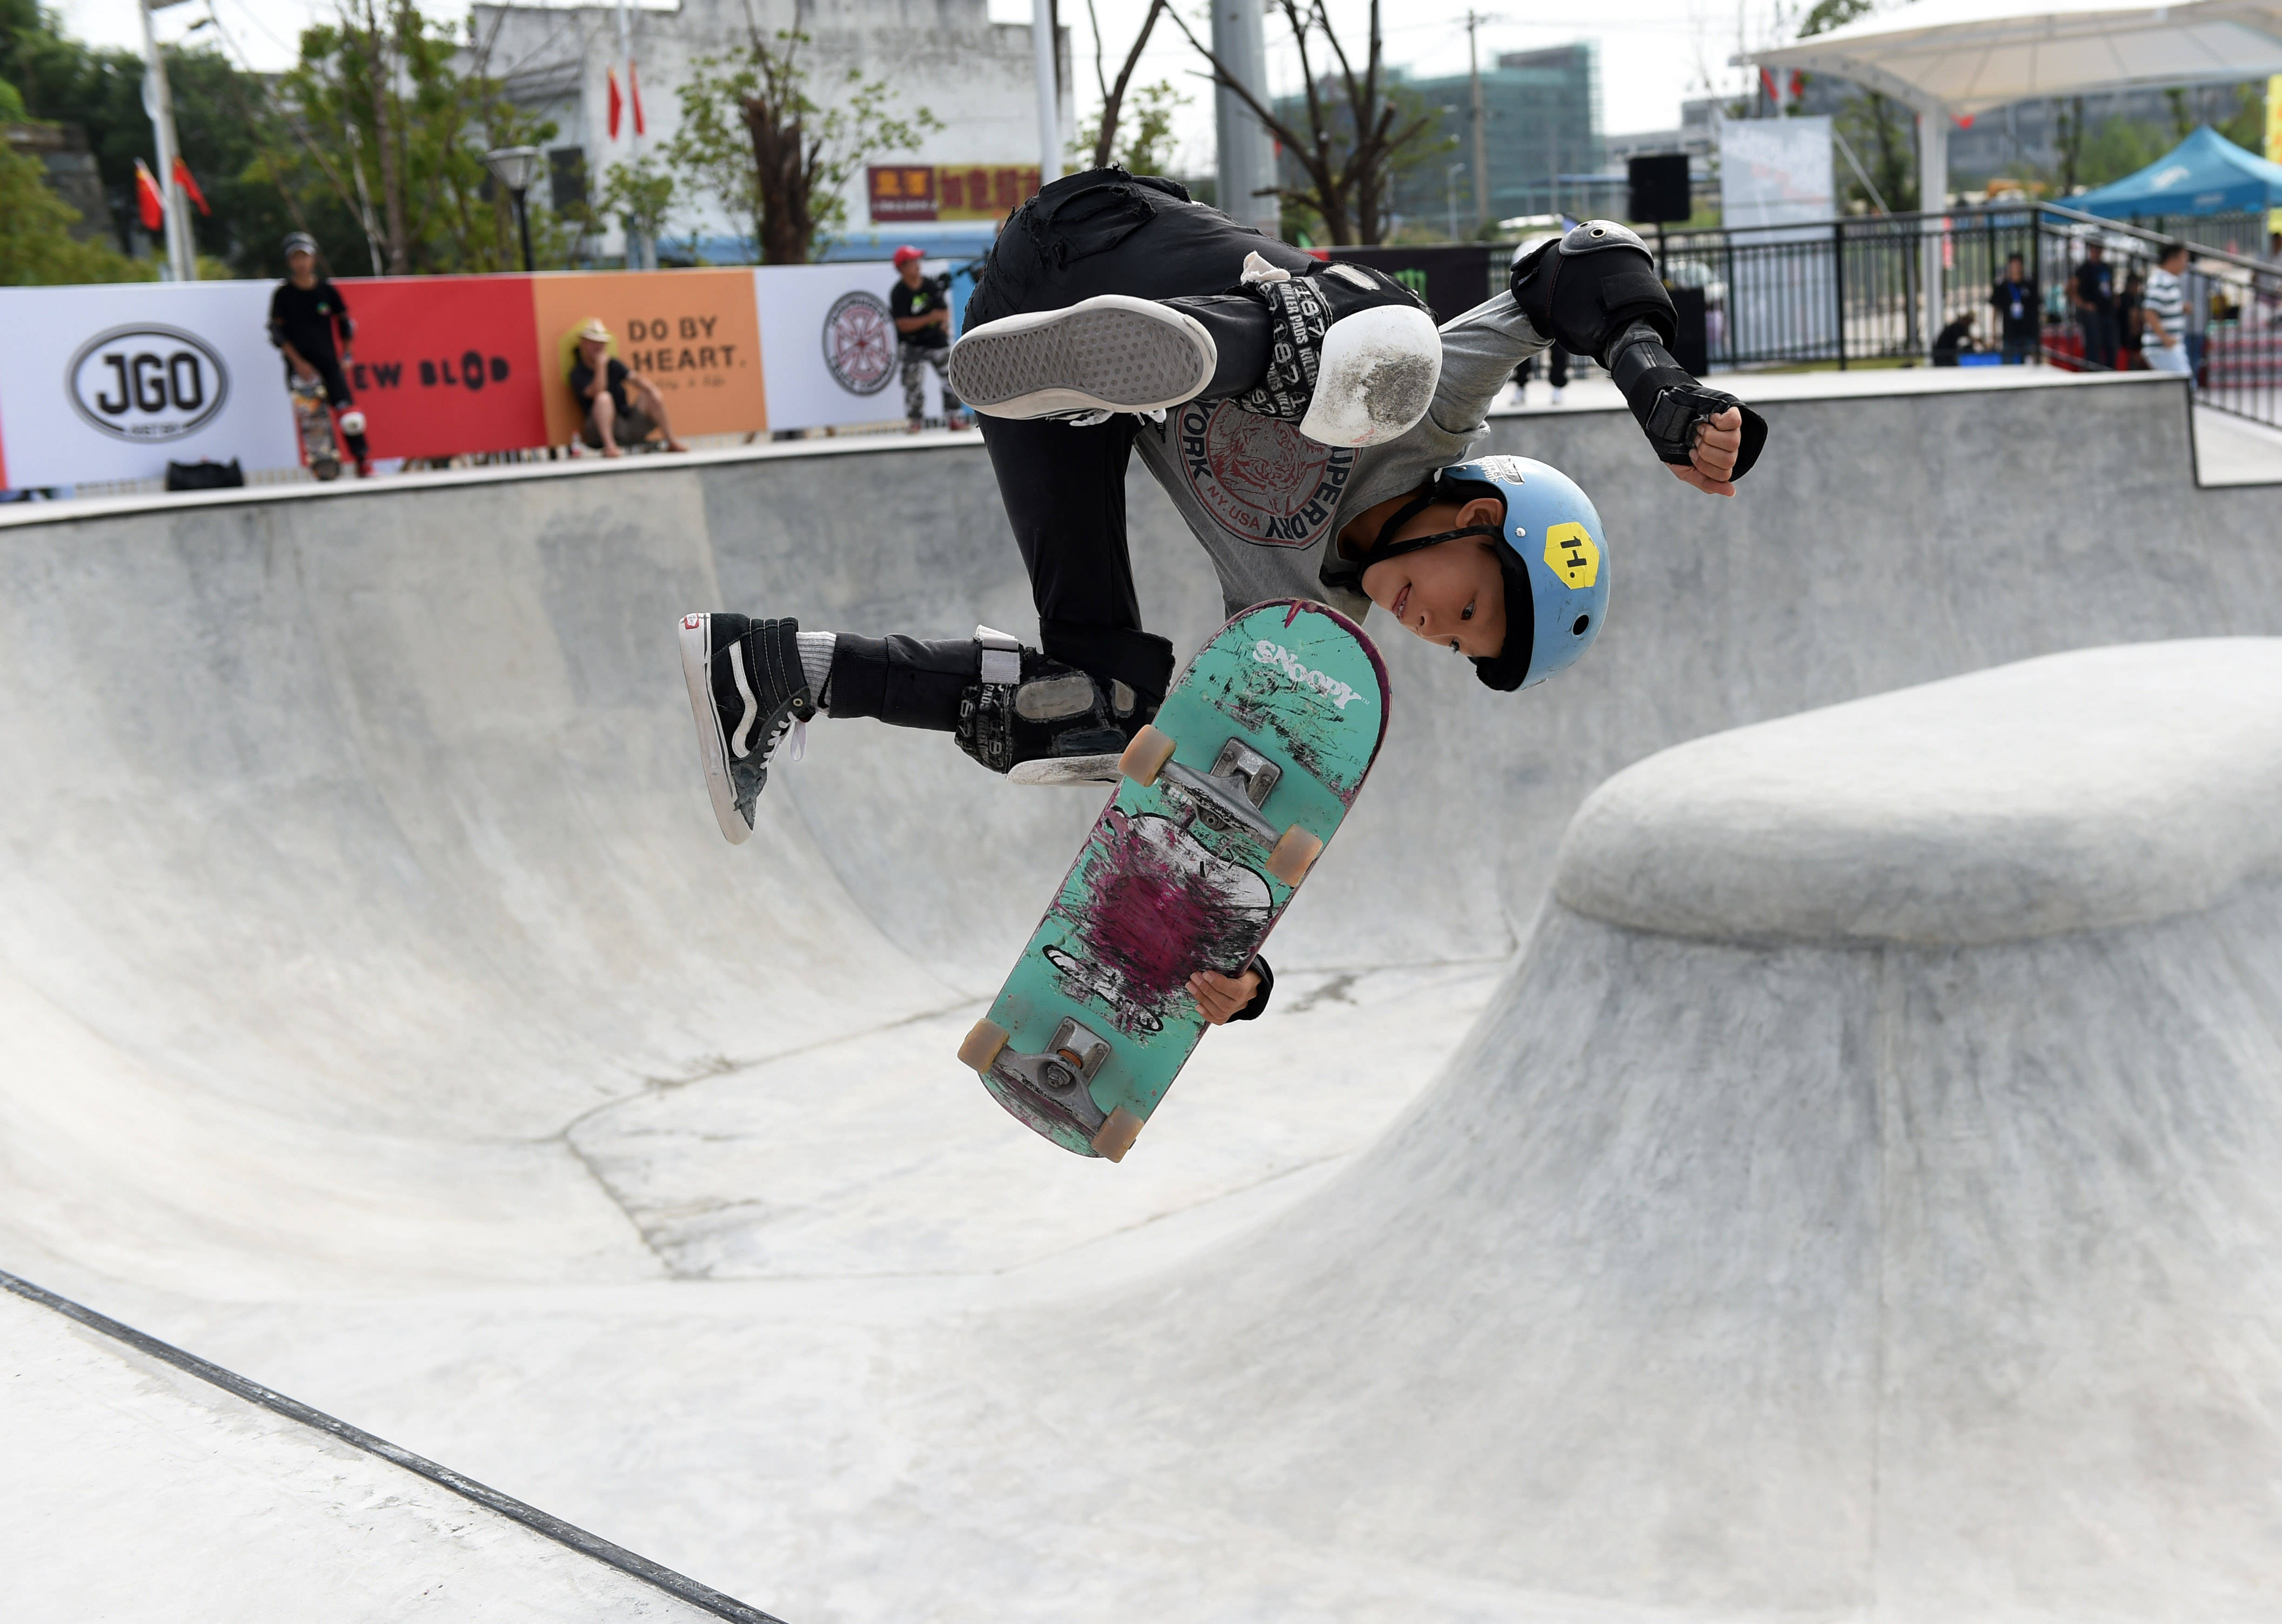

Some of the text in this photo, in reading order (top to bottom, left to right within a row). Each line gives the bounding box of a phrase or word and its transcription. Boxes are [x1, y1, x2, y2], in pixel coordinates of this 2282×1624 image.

[627, 314, 717, 341] DO BY
[1289, 315, 1309, 345] PADS
[1294, 286, 1325, 337] 187
[97, 351, 204, 415] JGO
[353, 350, 510, 392] EW BLOD
[631, 344, 746, 371] HEART.
[1183, 400, 1218, 480] YORK
[1265, 446, 1353, 539] UPERDRY
[1253, 640, 1362, 709] SNOOPY
